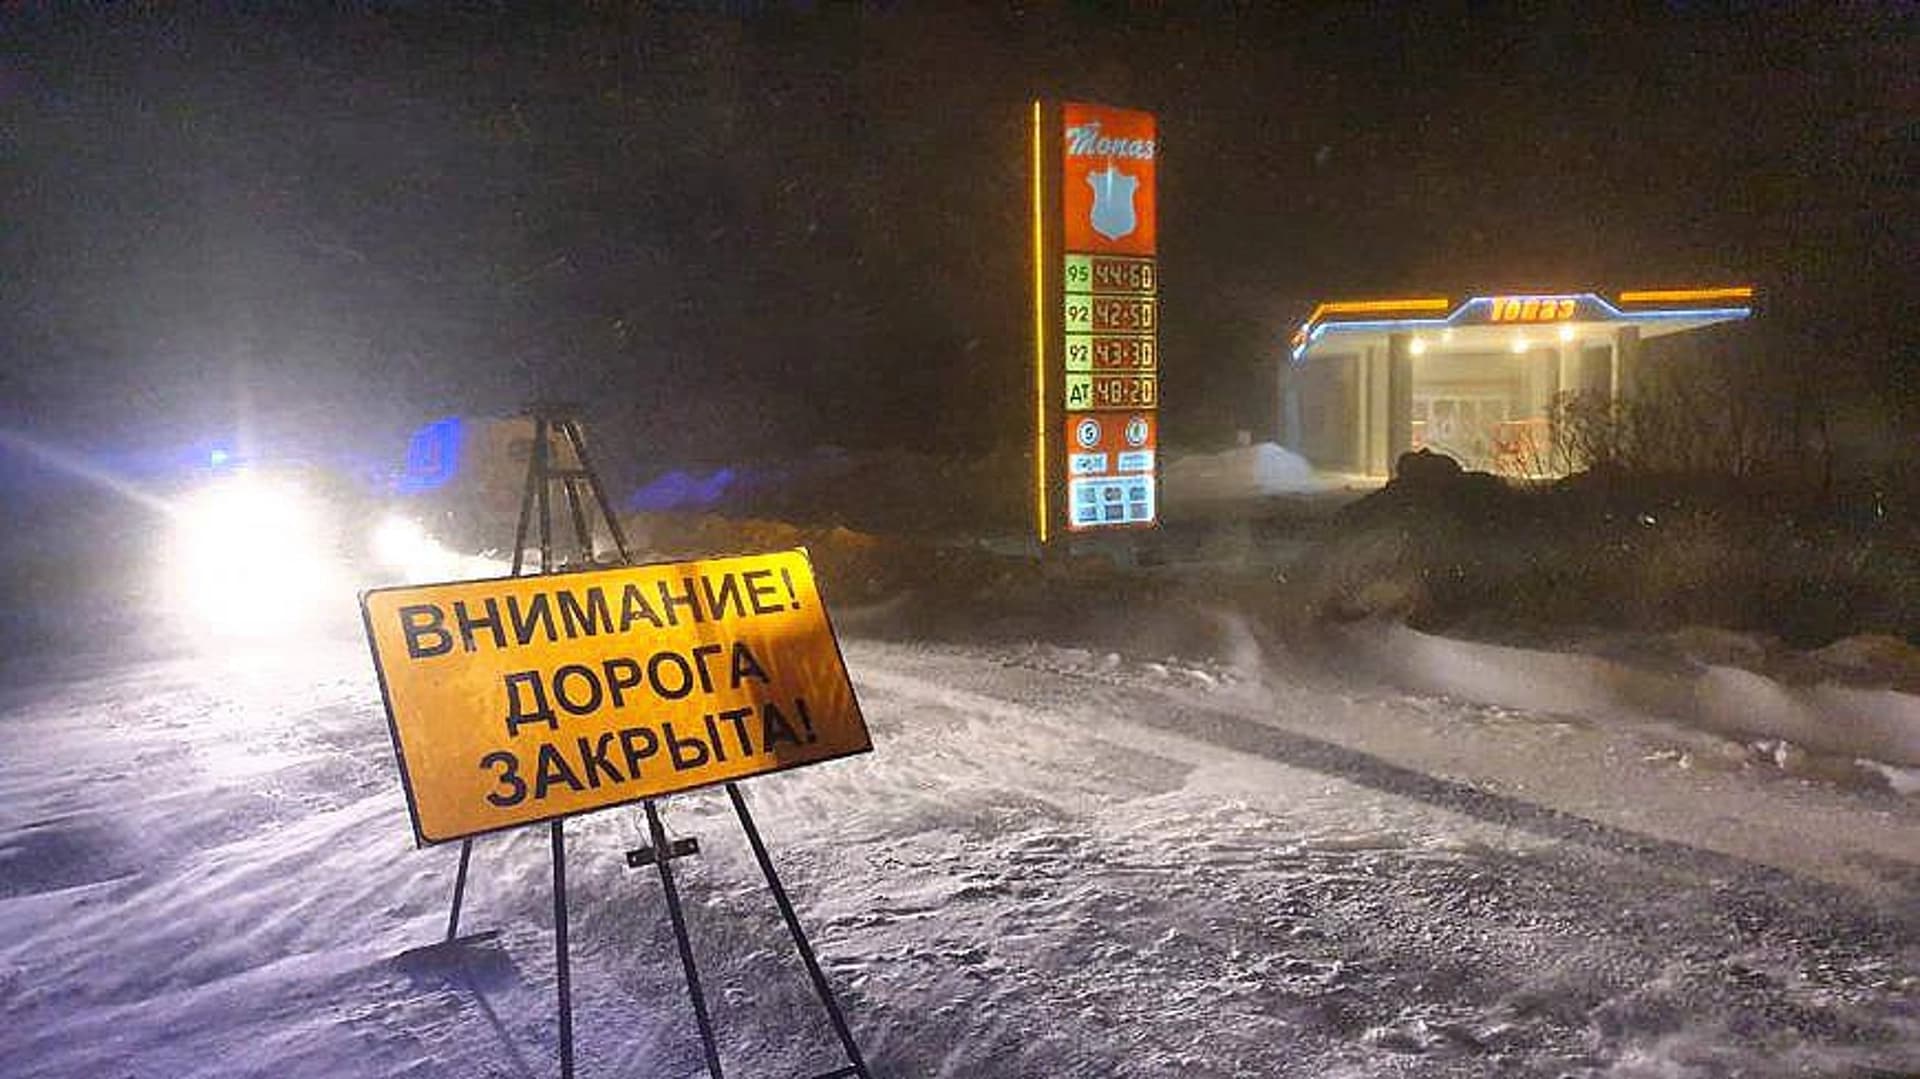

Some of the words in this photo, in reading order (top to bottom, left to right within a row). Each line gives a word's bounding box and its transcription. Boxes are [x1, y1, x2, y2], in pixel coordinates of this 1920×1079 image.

[1068, 264, 1089, 282] 95
[1068, 306, 1089, 322] 92
[1069, 345, 1089, 362] 92
[1070, 383, 1090, 404] ДТ
[400, 566, 802, 659] ВНИМАНИЕ!
[504, 640, 772, 737] ДОРОГА
[480, 698, 818, 806] ЗАКРЫТА!
